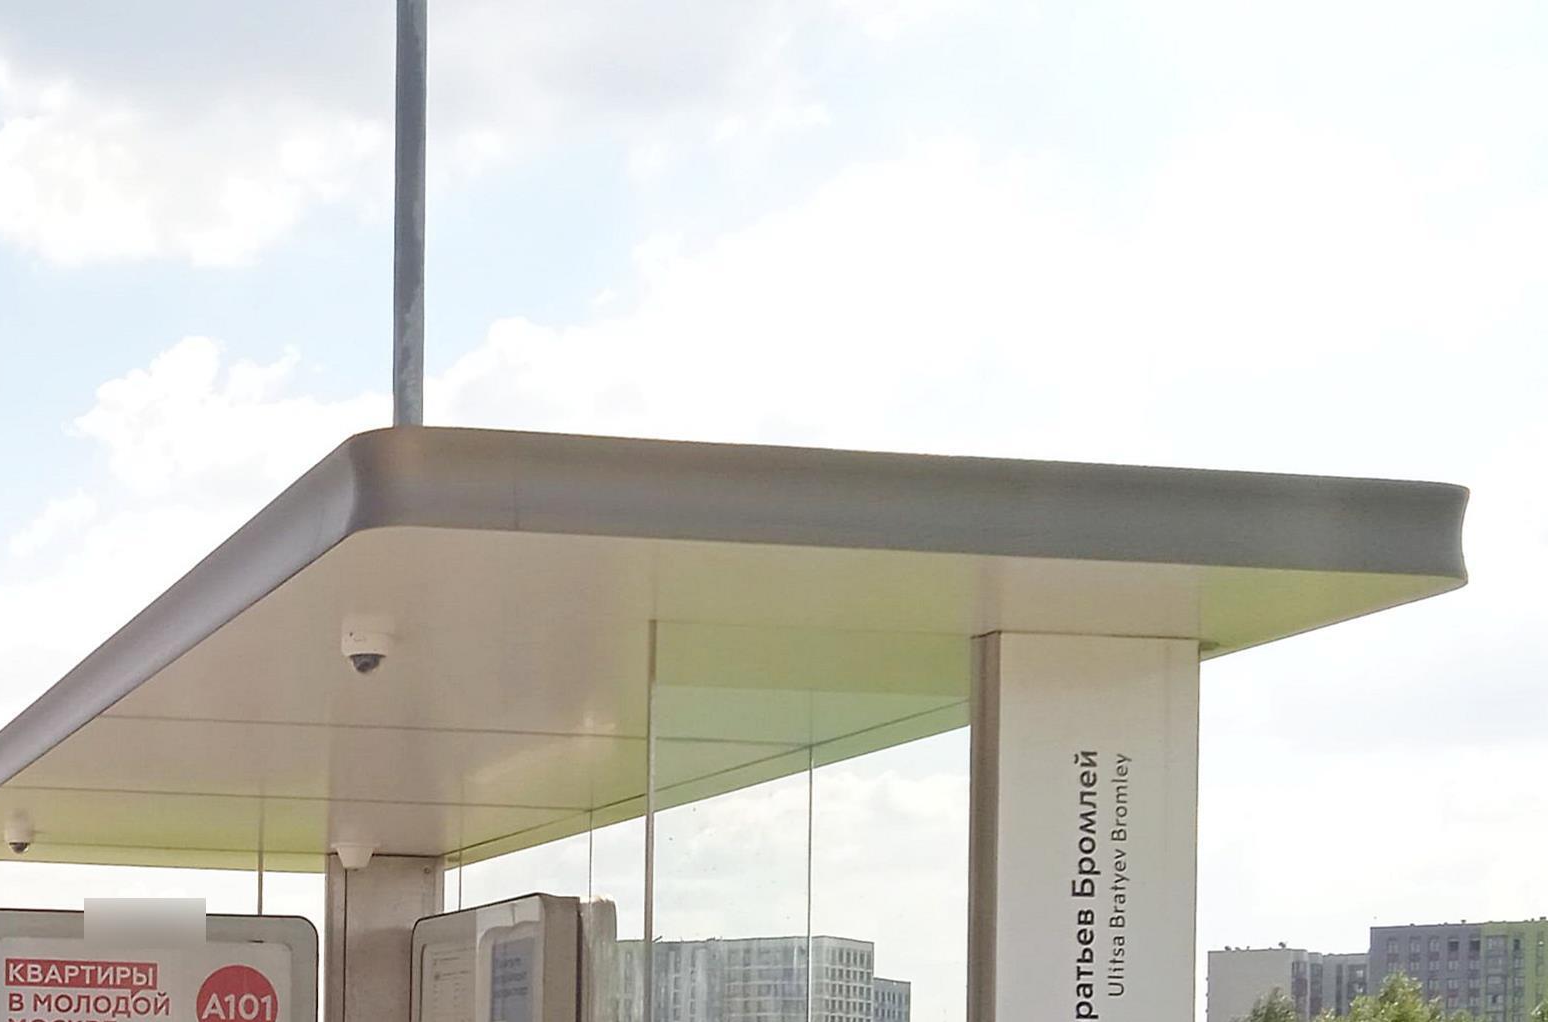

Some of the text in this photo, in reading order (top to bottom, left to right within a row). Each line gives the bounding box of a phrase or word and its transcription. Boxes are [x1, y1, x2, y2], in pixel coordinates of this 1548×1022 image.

[1071, 749, 1102, 898] Бромлей
[1108, 752, 1133, 997] Ulitsa Bratyev Bromley
[8, 963, 153, 986] КВАРТИРЫ
[8, 992, 170, 1018] В МОЛОДОЙ
